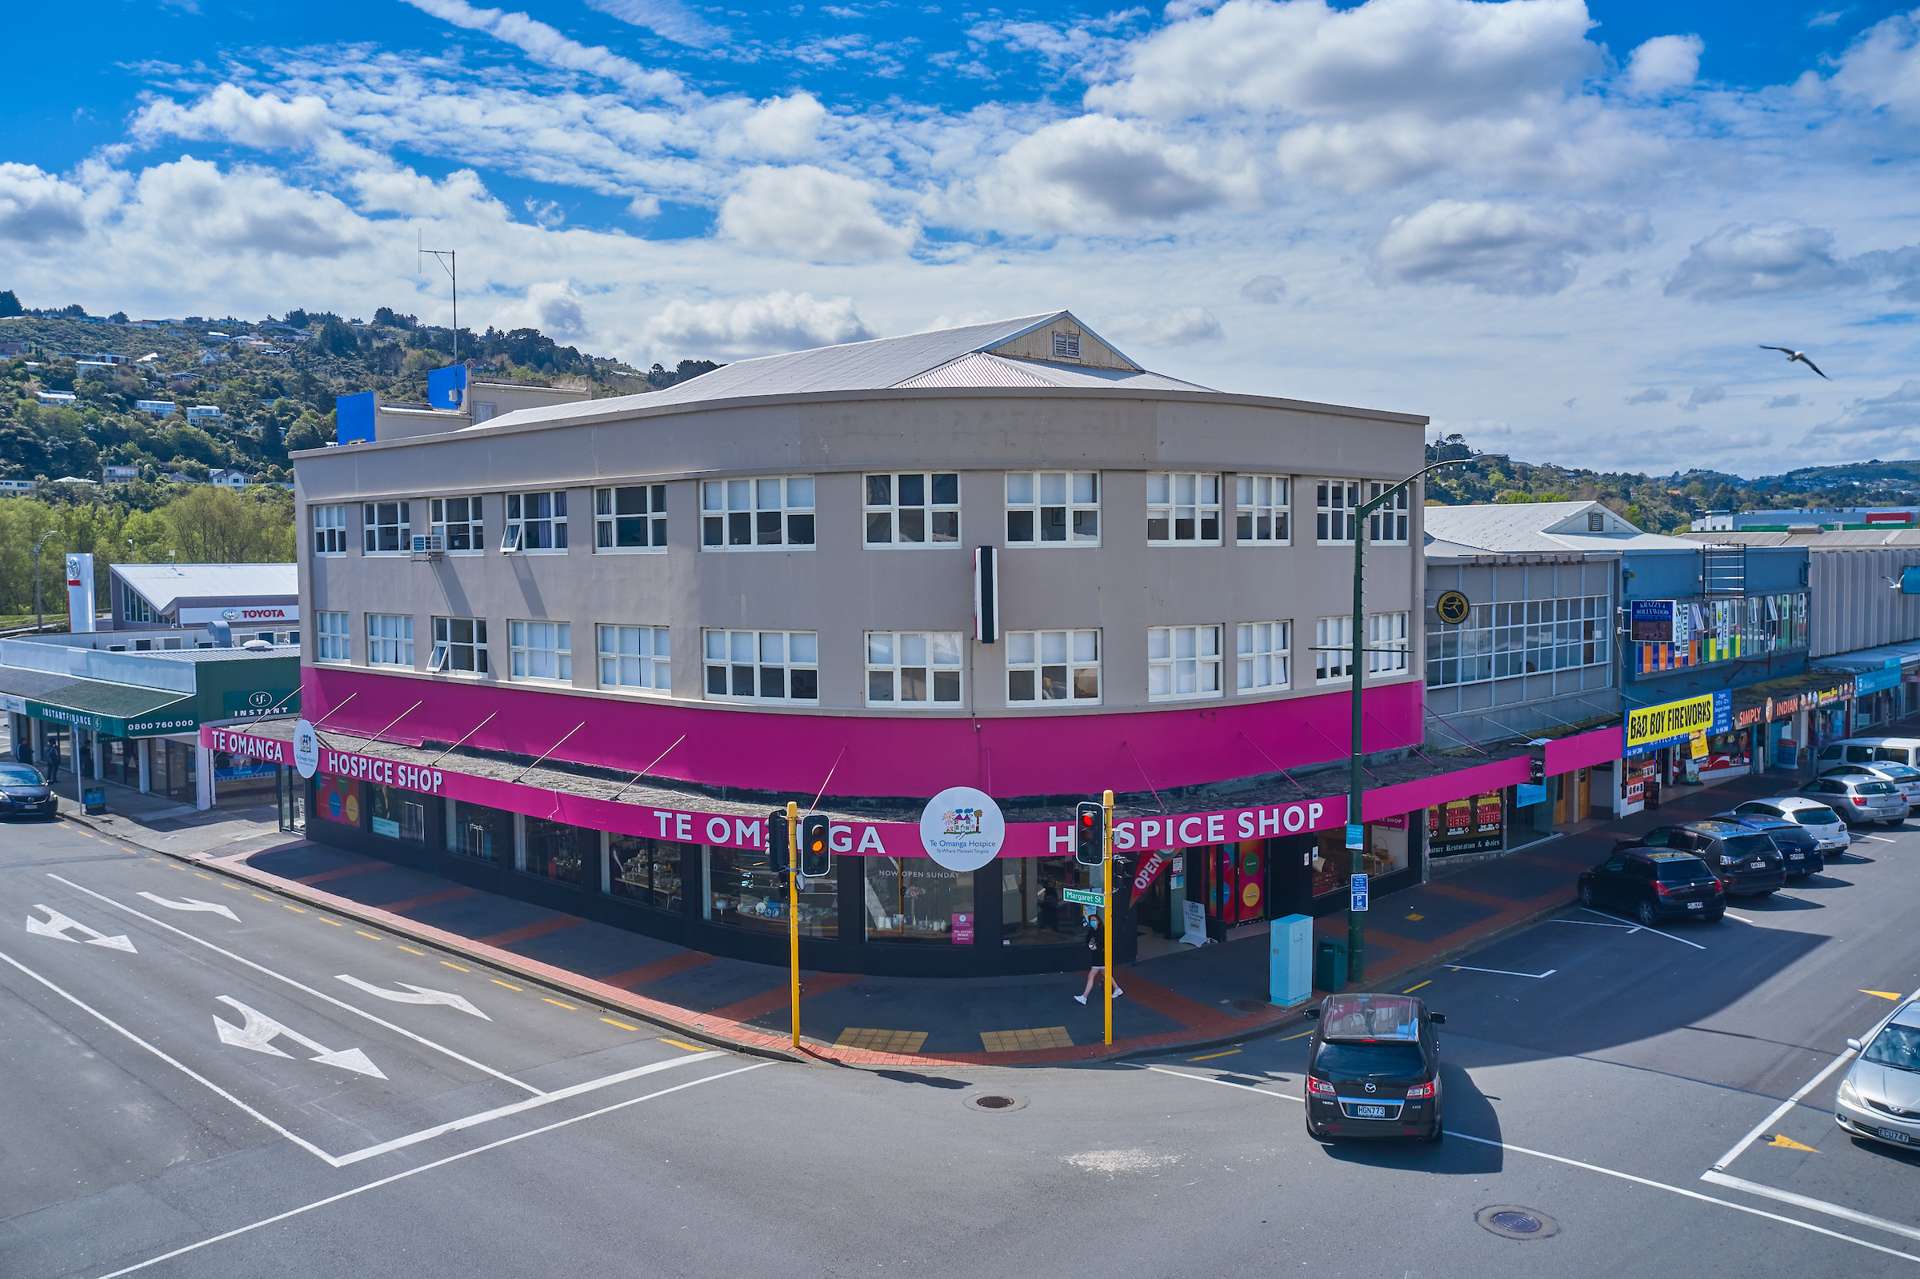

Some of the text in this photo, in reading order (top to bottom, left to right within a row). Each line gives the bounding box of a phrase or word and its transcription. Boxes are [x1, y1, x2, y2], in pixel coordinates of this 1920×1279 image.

[242, 609, 286, 618] TOYOTA
[234, 707, 288, 717] INSTANT
[1630, 714, 1648, 740] BAD
[1650, 710, 1666, 735] BOY
[1668, 700, 1711, 731] FIREWORKS
[1740, 707, 1762, 726] SIMPLY
[1776, 697, 1798, 716] INDIAN
[212, 730, 226, 750] TE
[230, 734, 283, 762] OMANGA
[328, 752, 443, 793] HOSPICE SHOP
[654, 811, 886, 854] TE OMGA
[1049, 813, 1225, 853] HSPICE
[1238, 802, 1324, 838] SHOP
[939, 840, 967, 848] Omanga
[969, 840, 996, 848] Hospice
[1134, 853, 1164, 889] OPEN
[1066, 892, 1102, 903] Margaret St
